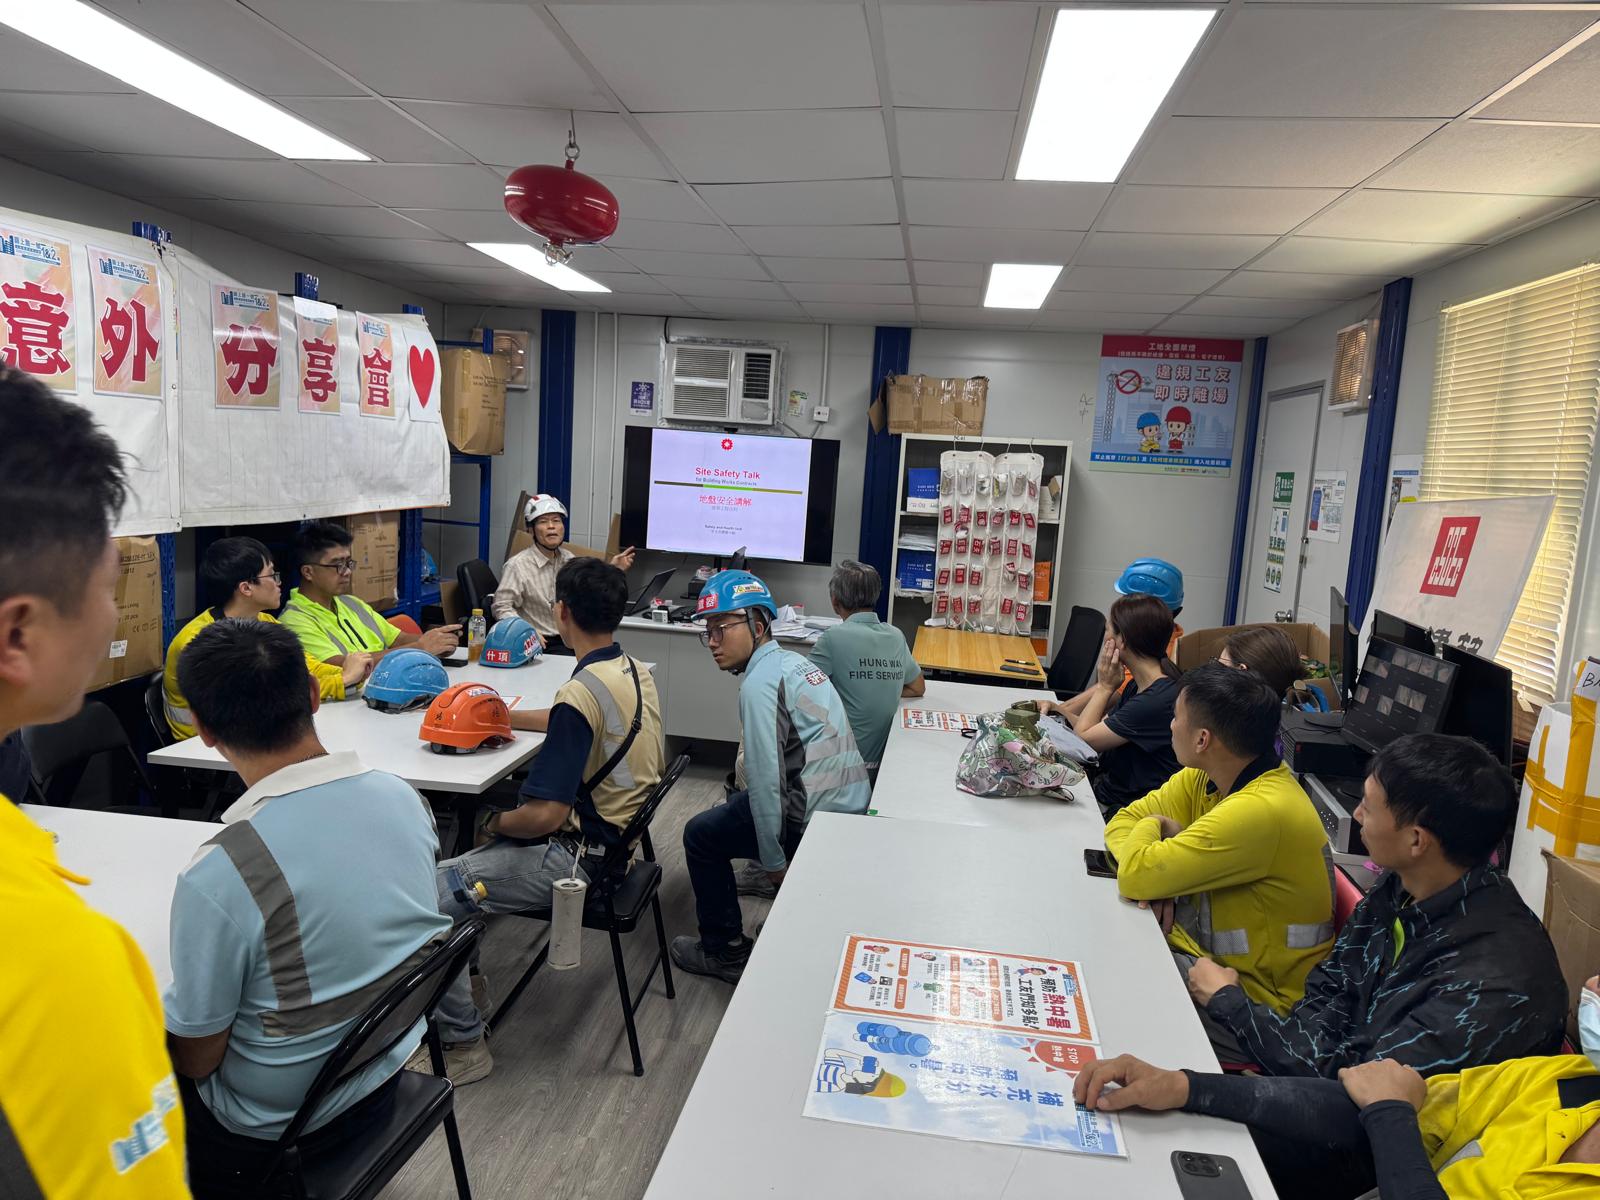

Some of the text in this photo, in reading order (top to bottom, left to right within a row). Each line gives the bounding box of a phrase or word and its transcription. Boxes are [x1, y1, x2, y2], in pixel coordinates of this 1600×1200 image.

[1155, 363, 1231, 383] 違規工友
[1153, 384, 1229, 404] 即時離場
[695, 467, 761, 480] Site Safety Talk
[699, 495, 752, 506] 地盤安全講解
[859, 657, 888, 668] HUNG
[849, 670, 874, 680] FIRE
[1040, 977, 1072, 1029] 預防熱中暑
[1067, 1047, 1079, 1065] STOP
